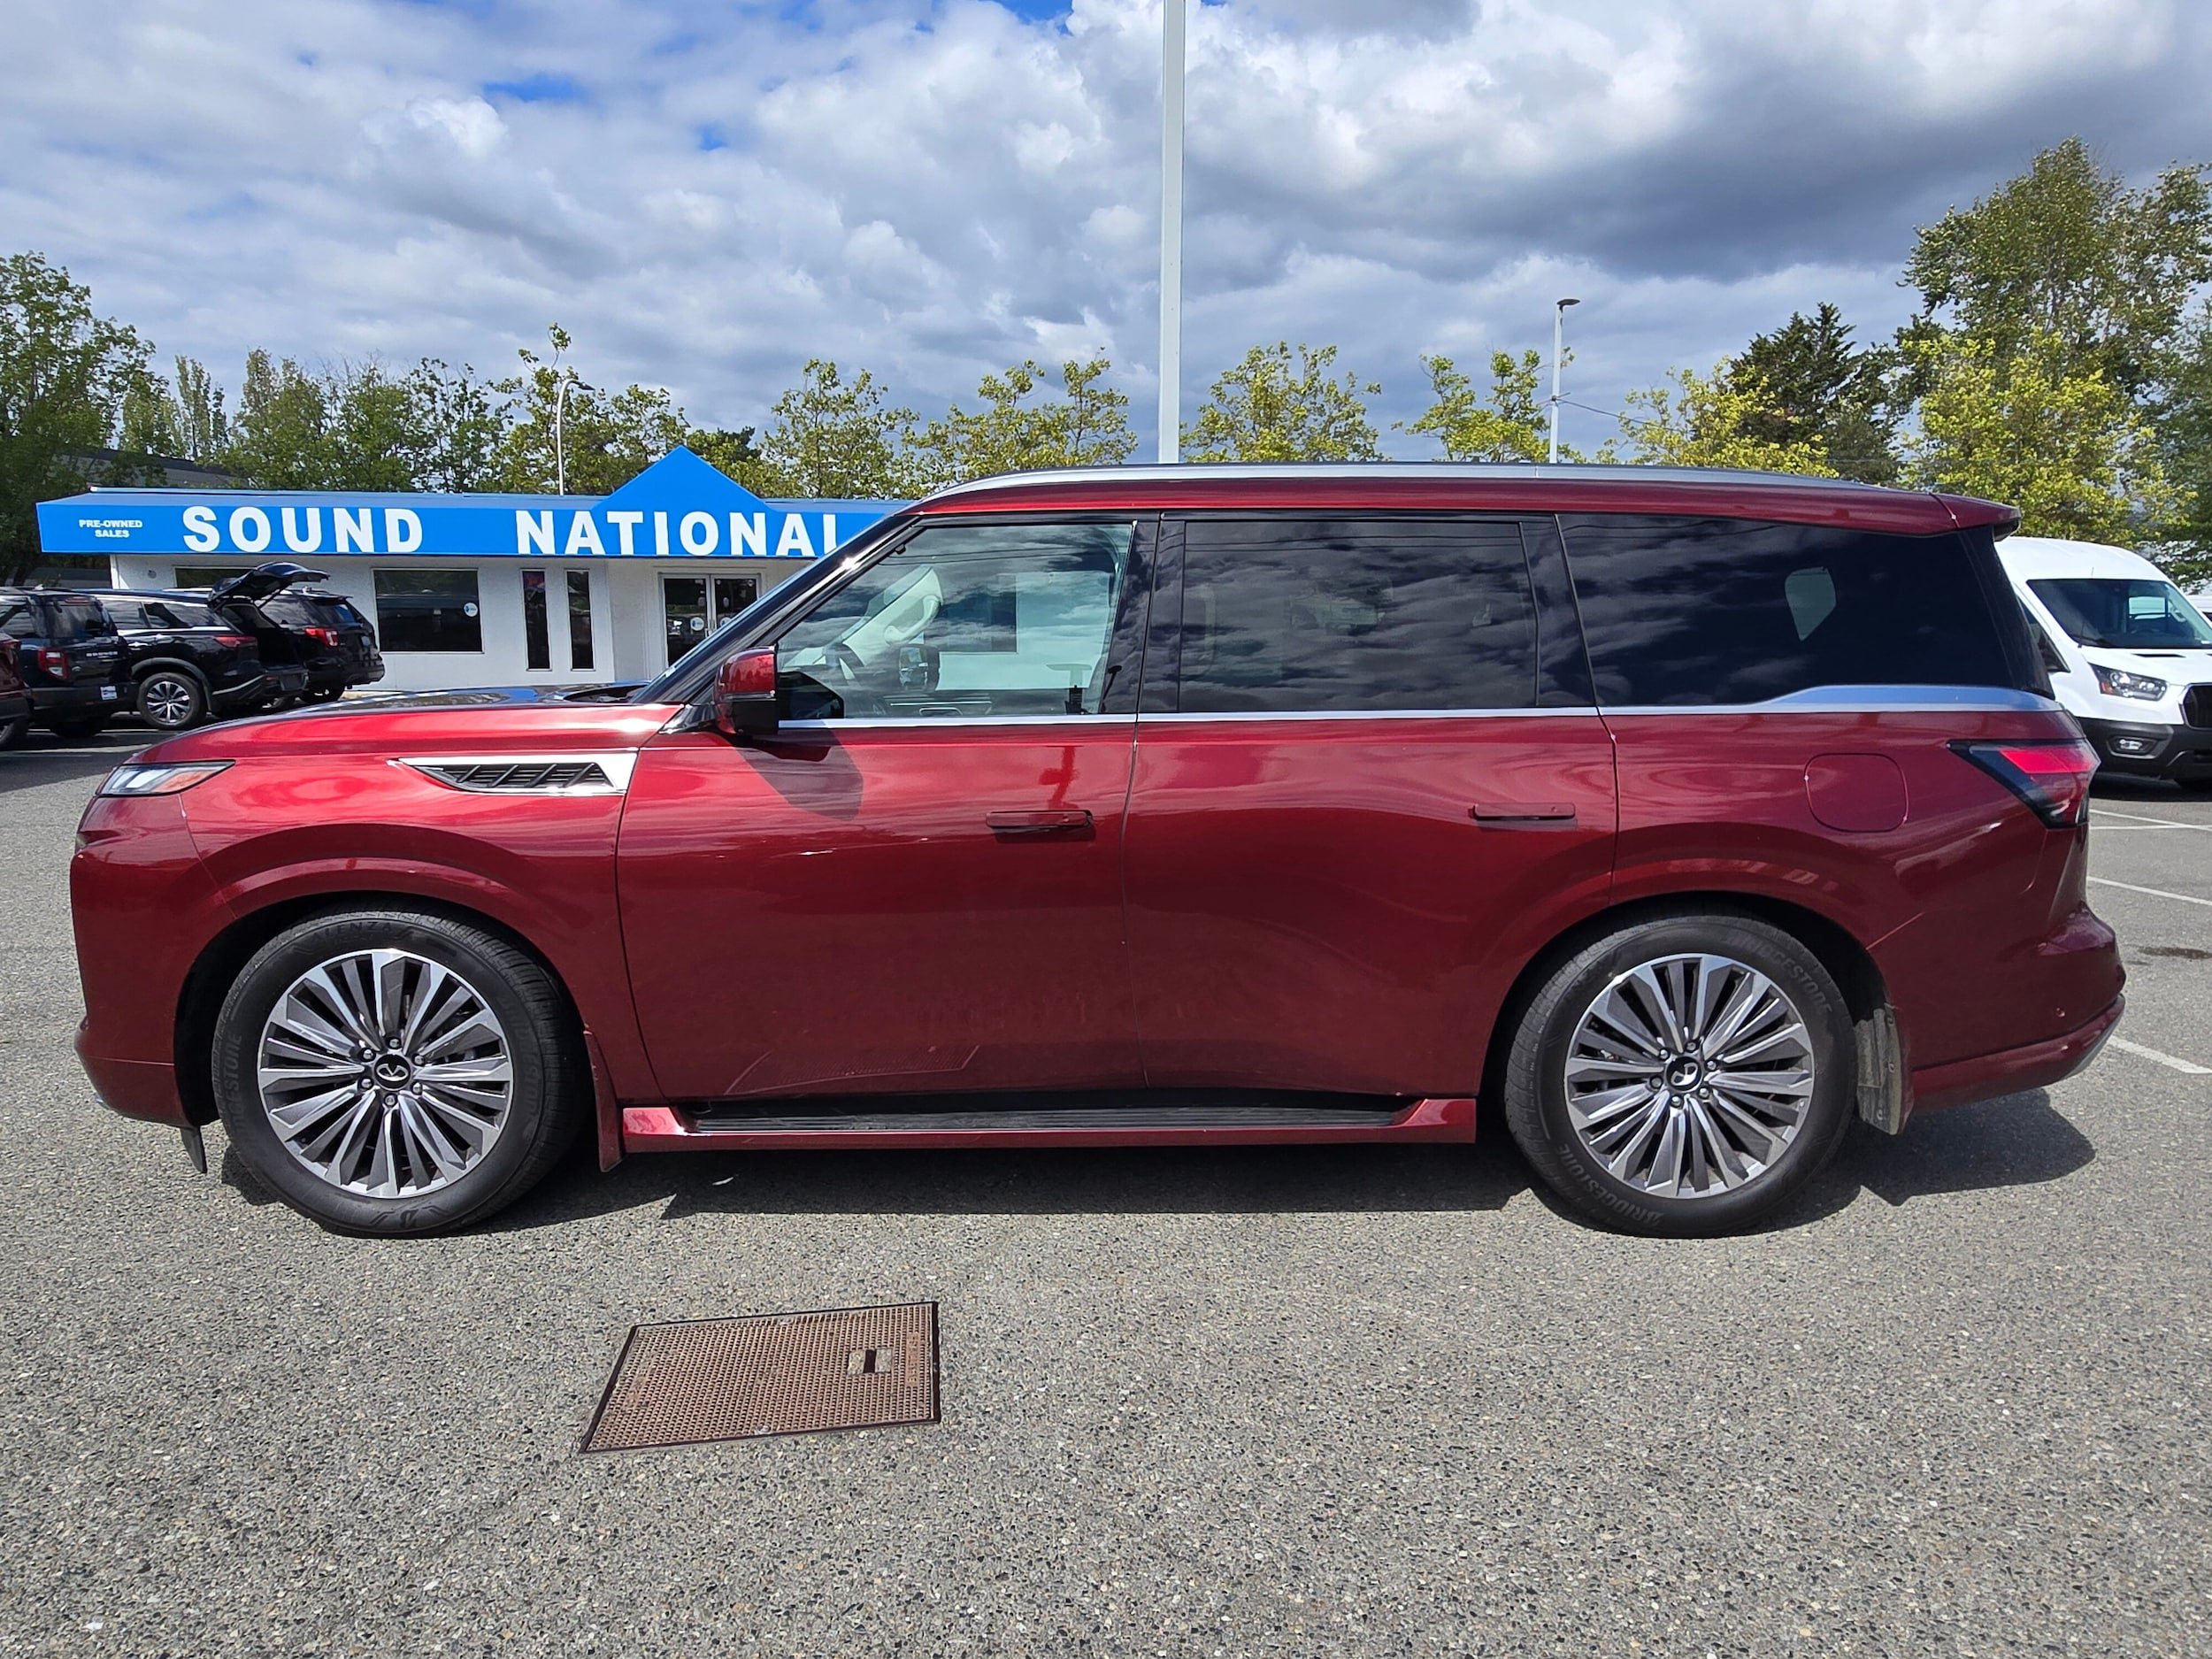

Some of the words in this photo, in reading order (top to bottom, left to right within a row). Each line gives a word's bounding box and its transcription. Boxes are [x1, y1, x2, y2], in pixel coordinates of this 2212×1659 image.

[79, 519, 142, 528] PRE-OWNED
[95, 529, 129, 538] SALES
[183, 505, 423, 554] SOUND
[516, 510, 836, 557] NATIONAL
[224, 1033, 257, 1148] IDGESTONE
[495, 995, 541, 1128] BRIDESTON
[1556, 1143, 1664, 1226] BRIDGESTONE
